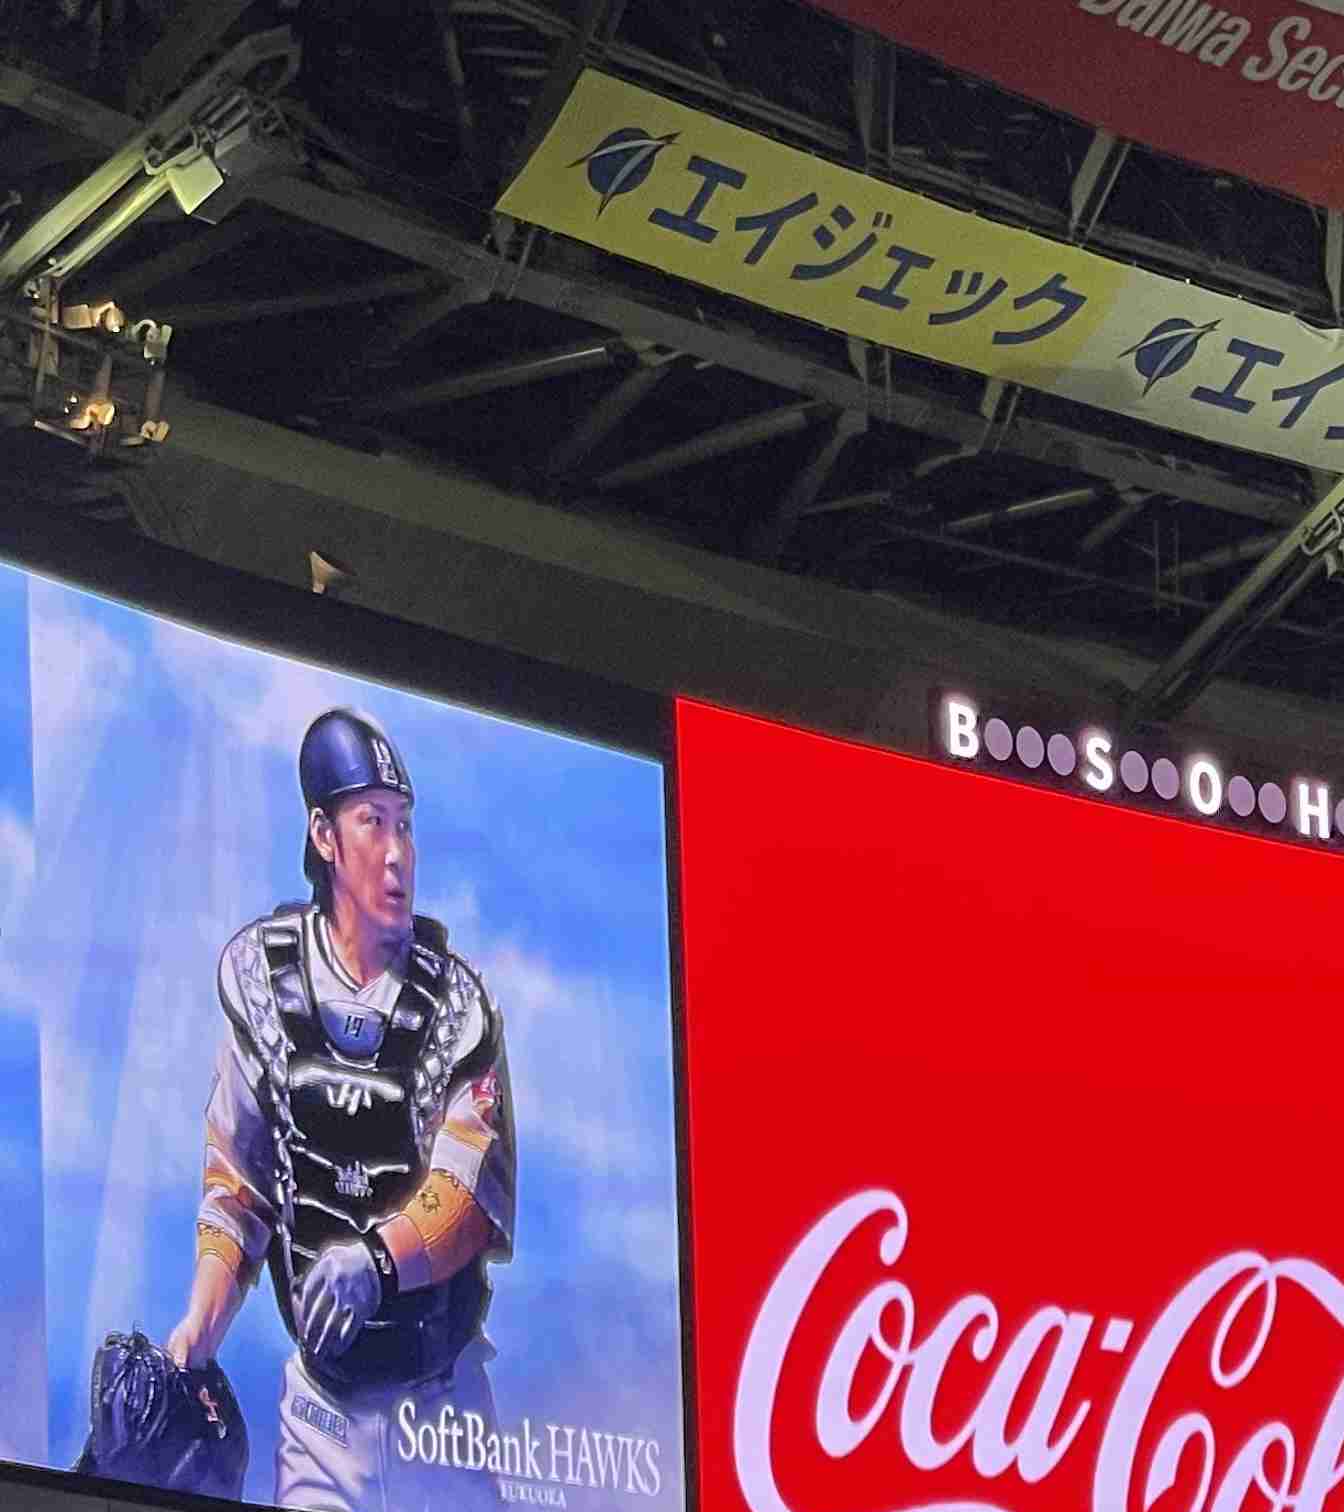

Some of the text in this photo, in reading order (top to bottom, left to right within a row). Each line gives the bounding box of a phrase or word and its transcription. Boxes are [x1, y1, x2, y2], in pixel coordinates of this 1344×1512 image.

[1078, 0, 1250, 67] aiwa
[648, 154, 1088, 344] エイジェック
[946, 702, 979, 758] B
[1085, 737, 1115, 791] S
[1189, 761, 1223, 815] O
[1298, 783, 1331, 839] H
[399, 1398, 543, 1480] SoftBank
[547, 1424, 661, 1497] HAWKS
